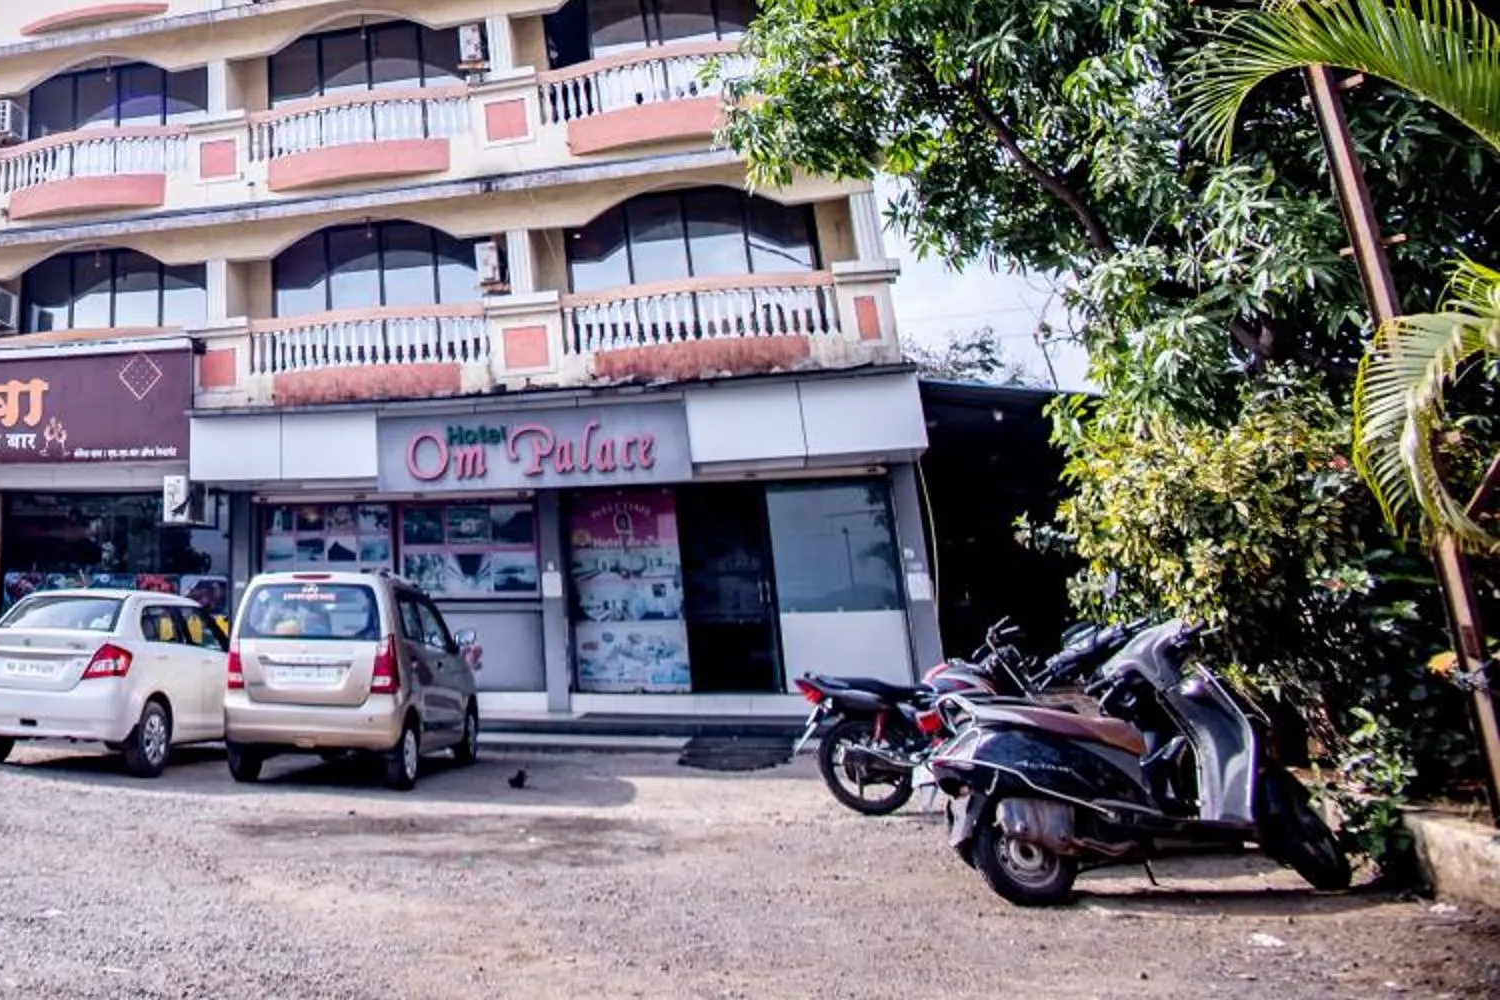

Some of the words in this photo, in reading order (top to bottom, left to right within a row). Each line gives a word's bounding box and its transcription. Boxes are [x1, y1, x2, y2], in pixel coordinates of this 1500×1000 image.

[7, 432, 37, 450] बार
[446, 425, 507, 447] Hotel
[406, 430, 488, 482] Om
[509, 420, 657, 477] Palace
